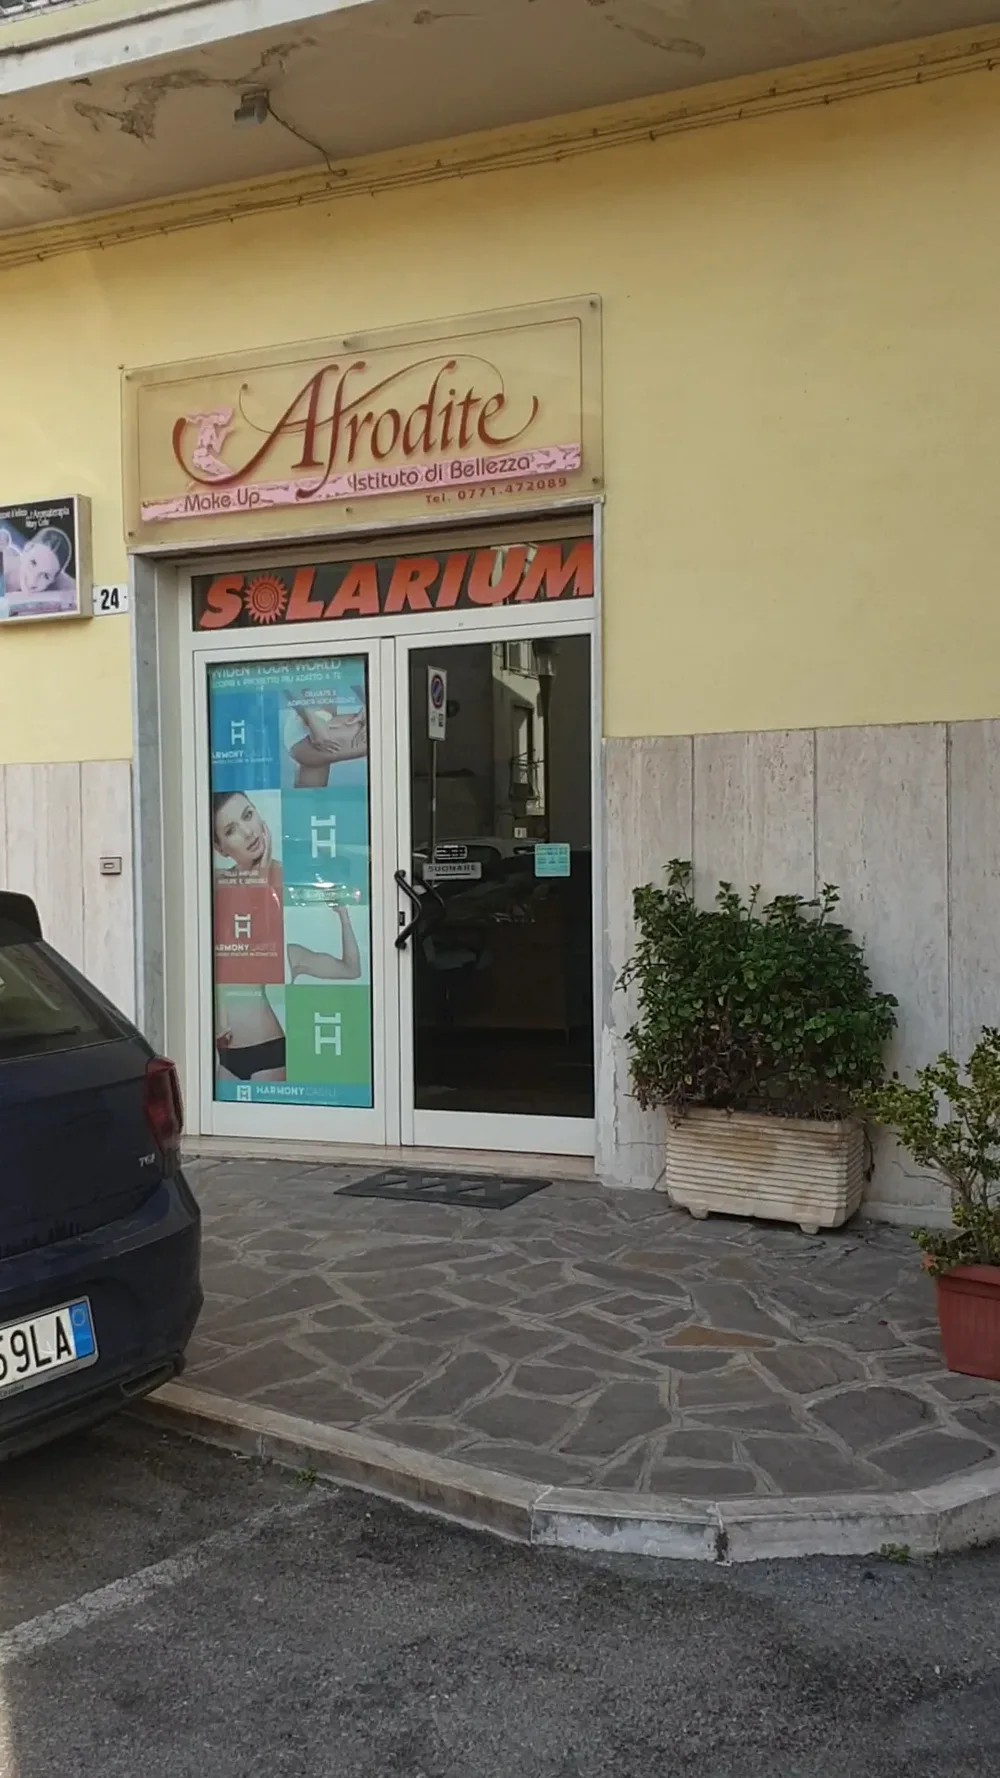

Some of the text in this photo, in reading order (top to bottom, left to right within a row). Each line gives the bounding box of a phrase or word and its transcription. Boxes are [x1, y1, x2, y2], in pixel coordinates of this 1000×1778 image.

[172, 353, 539, 499] Afrodite
[352, 453, 530, 492] Istituto di Bellezza
[184, 488, 261, 512] Make Up
[426, 477, 568, 504] Tel. 0771.472089
[100, 587, 120, 611] 24
[199, 541, 594, 631] SOLARIUM
